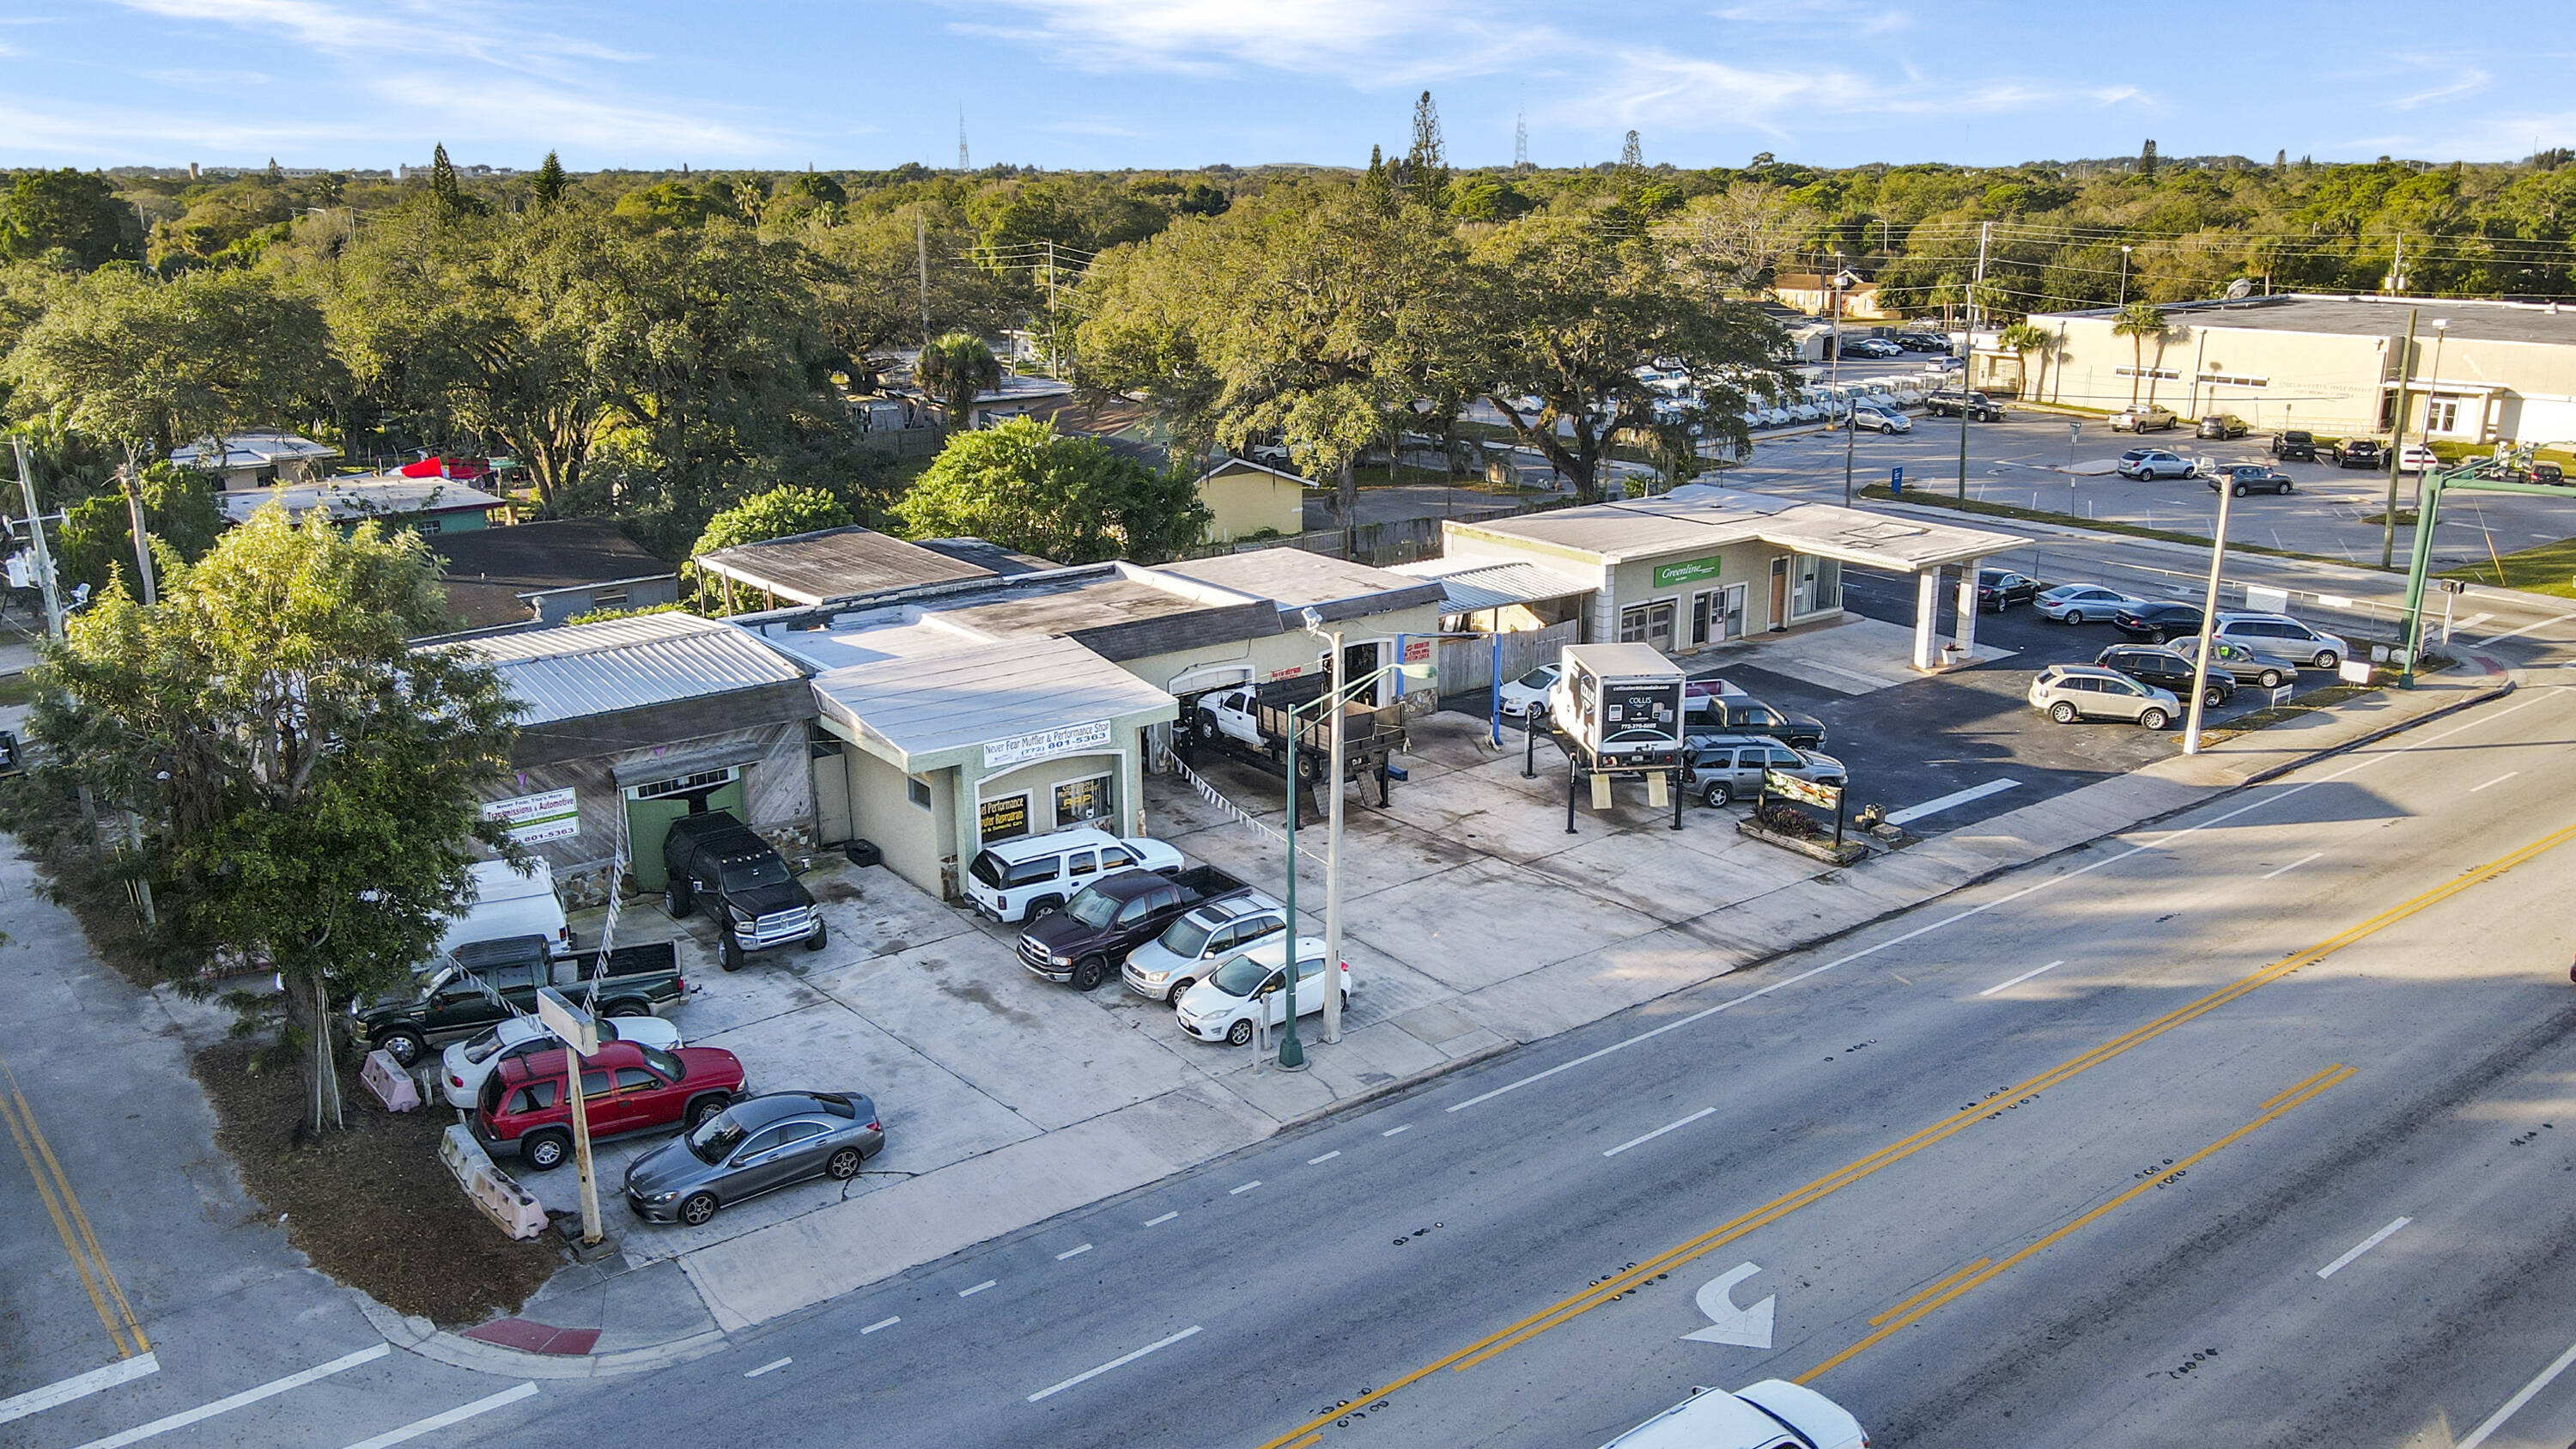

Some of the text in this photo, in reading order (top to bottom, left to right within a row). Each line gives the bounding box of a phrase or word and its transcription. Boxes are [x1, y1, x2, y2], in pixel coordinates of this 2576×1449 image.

[1662, 563, 1702, 579] Greenline
[985, 744, 1005, 755] Never
[1005, 740, 1020, 752] Fear
[1022, 734, 1045, 747] Muffler
[1054, 726, 1093, 741] Performance
[1094, 722, 1109, 734] Shop
[1021, 746, 1045, 756] (772)
[1048, 732, 1106, 750] 801-5363
[539, 798, 574, 810] Automotive
[987, 797, 1024, 814] Performance
[525, 827, 574, 843] 801-5363
